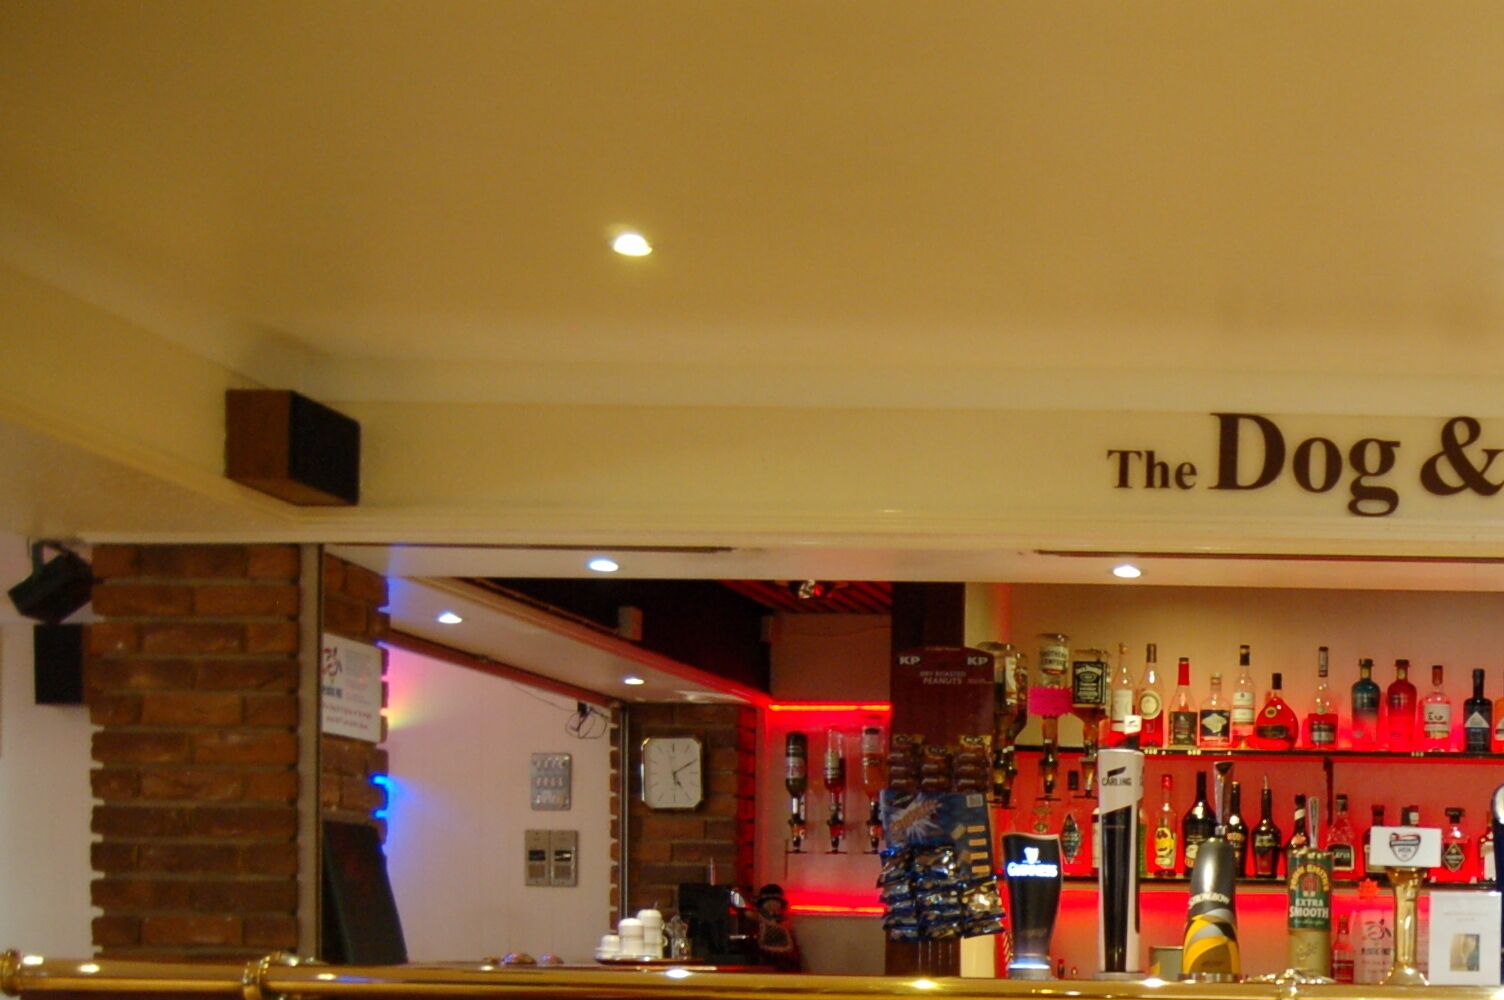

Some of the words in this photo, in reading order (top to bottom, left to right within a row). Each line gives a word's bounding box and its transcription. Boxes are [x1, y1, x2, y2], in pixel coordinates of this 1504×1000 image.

[1107, 448, 1198, 490] The
[1207, 411, 1402, 518] Dog
[899, 656, 920, 665] KP
[967, 656, 989, 666] KP
[1102, 777, 1132, 787] CARLING
[1295, 898, 1324, 907] EXTRA
[1289, 905, 1330, 918] SMOOTH
